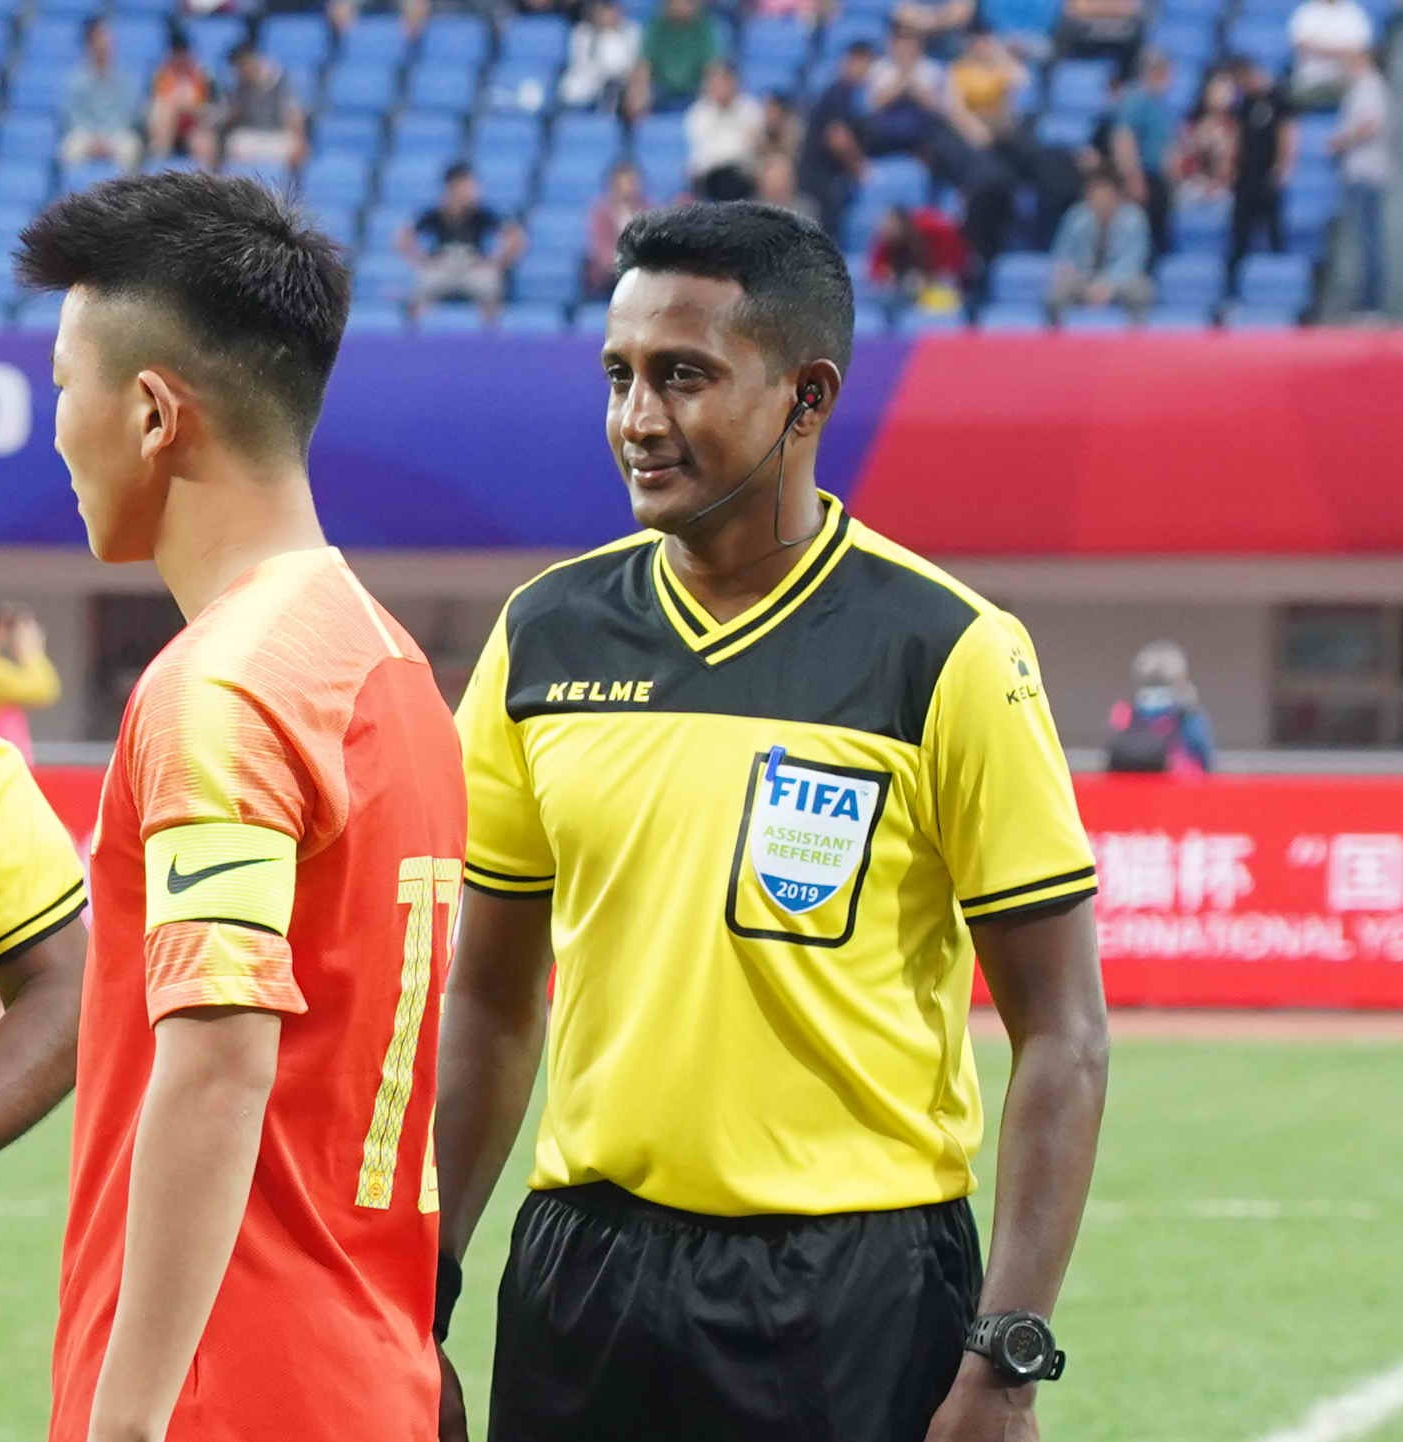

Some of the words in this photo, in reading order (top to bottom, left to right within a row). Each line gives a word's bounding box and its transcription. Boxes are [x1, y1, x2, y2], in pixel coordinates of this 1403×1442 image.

[545, 680, 653, 702] KELME
[769, 775, 860, 822] FIFA
[763, 825, 857, 851] ASSISTANT
[767, 842, 843, 867] REFEREE
[776, 882, 819, 903] 2019
